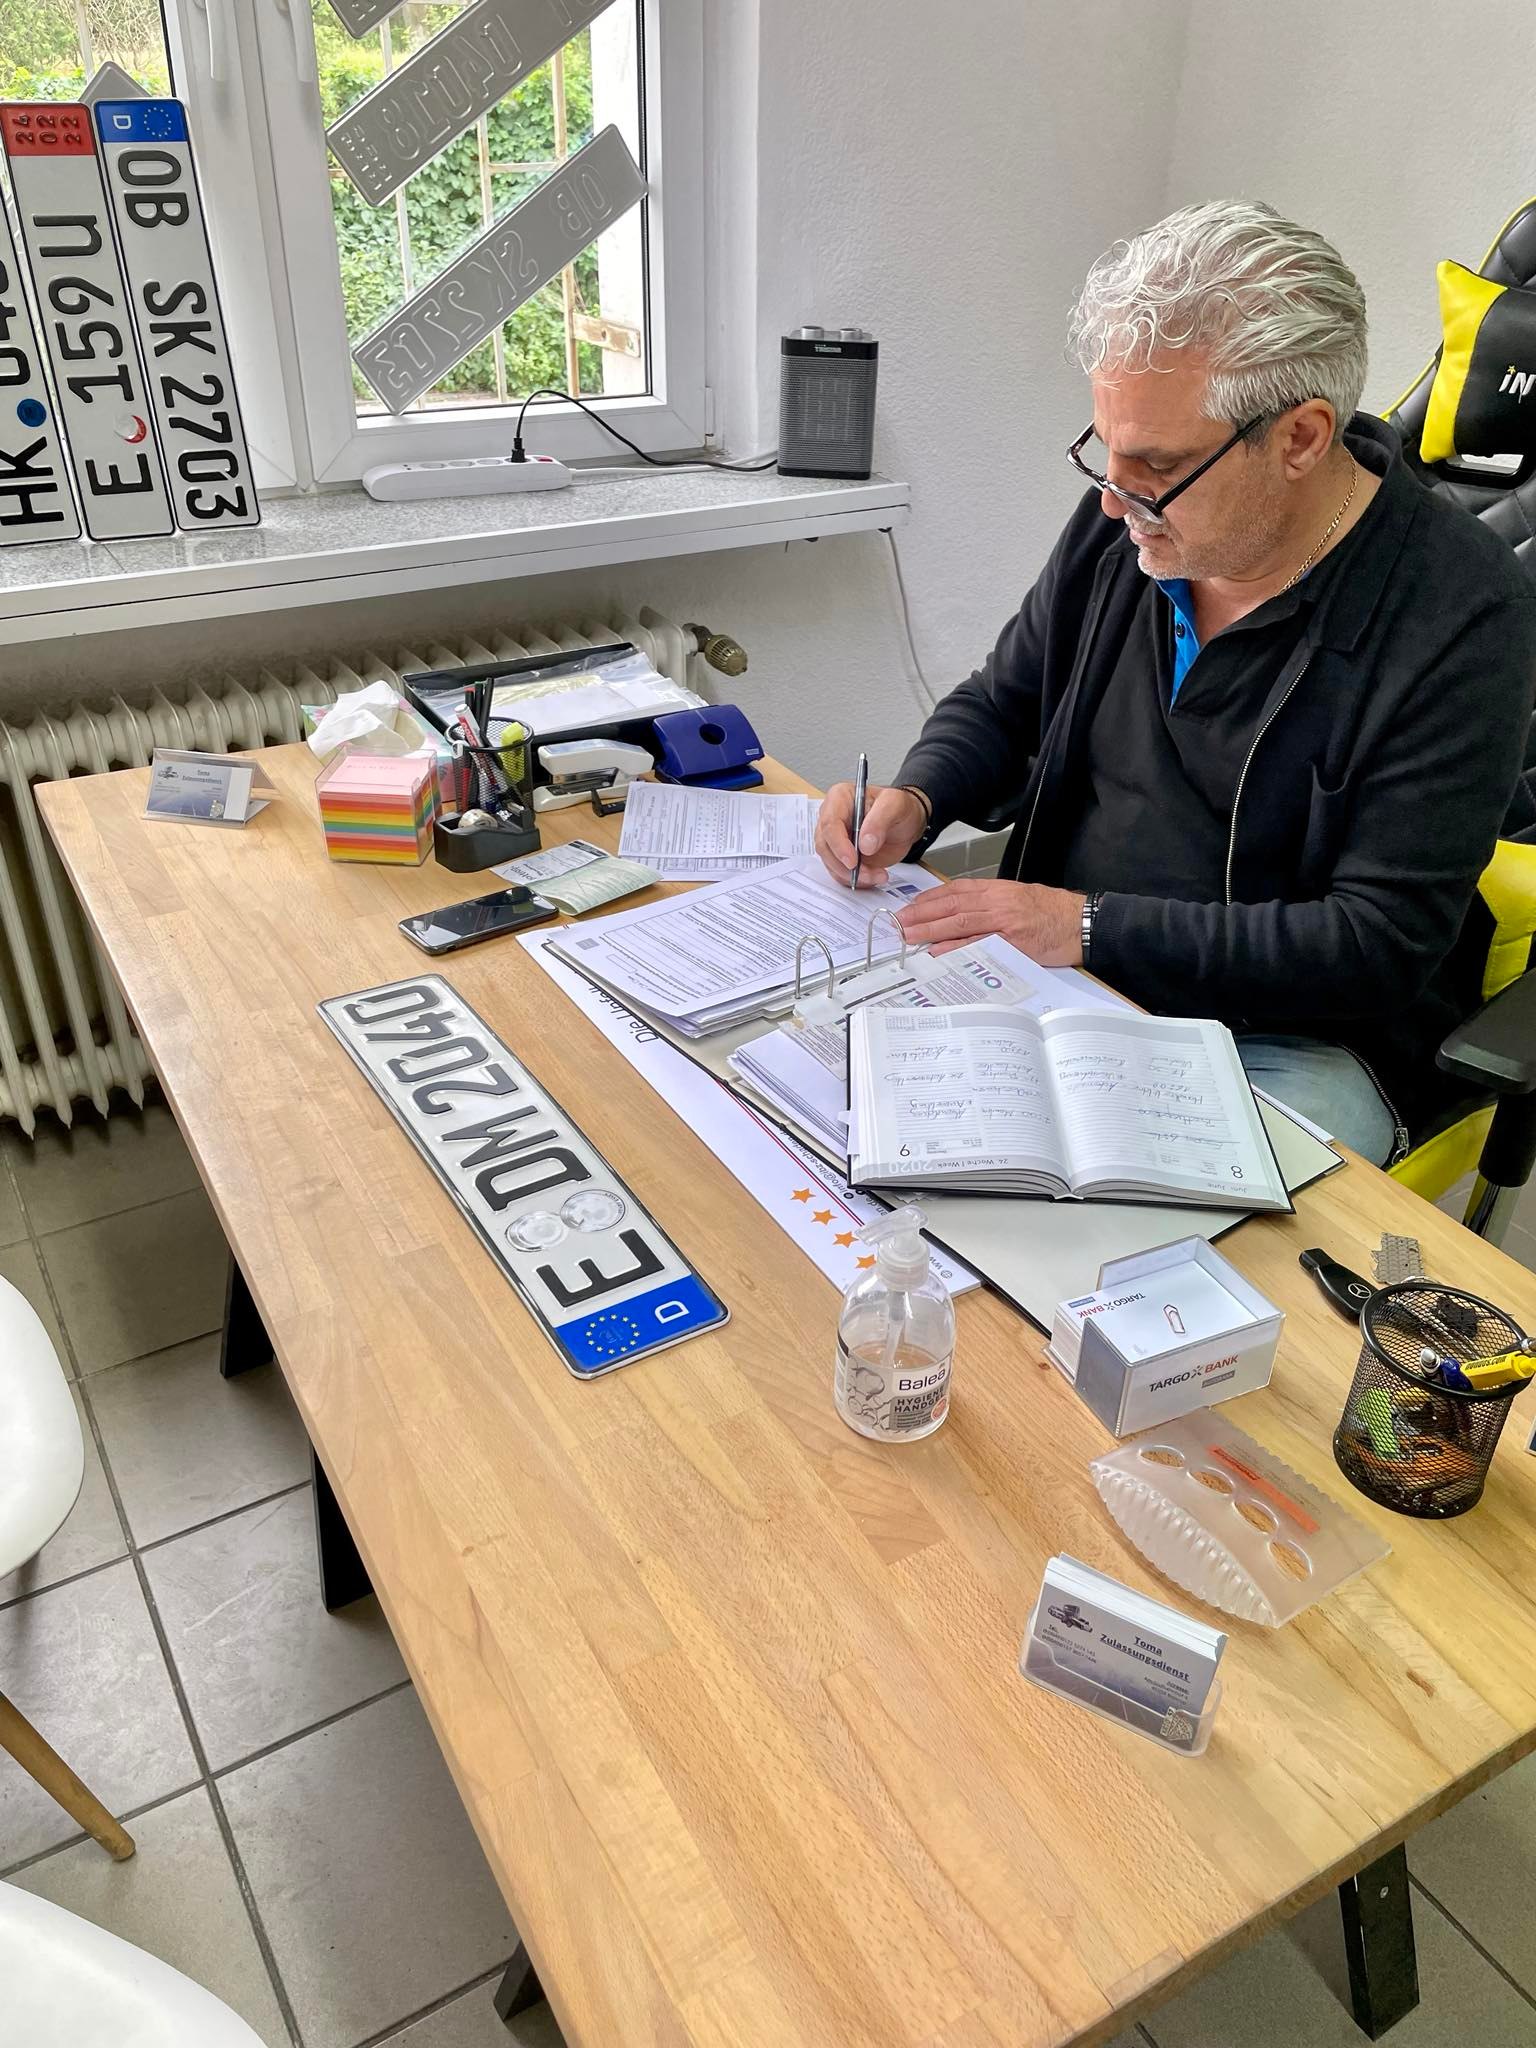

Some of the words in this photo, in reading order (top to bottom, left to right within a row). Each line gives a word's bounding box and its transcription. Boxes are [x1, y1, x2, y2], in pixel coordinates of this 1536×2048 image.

[112, 114, 132, 130] D
[118, 150, 190, 229] OB
[49, 276, 136, 404] 159
[143, 281, 217, 358] SK
[160, 374, 249, 519] 2703
[85, 452, 154, 496] E
[343, 984, 519, 1115] 2040
[440, 1105, 592, 1212] DM
[888, 1159, 933, 1174] 2020
[899, 1143, 910, 1157] 9
[1229, 1164, 1244, 1180] 8
[535, 1228, 665, 1308] E
[654, 1300, 689, 1324] D
[898, 1368, 947, 1392] Balea
[1099, 1632, 1191, 1684] Zulassungsdienst
[1134, 1636, 1163, 1656] Toma
